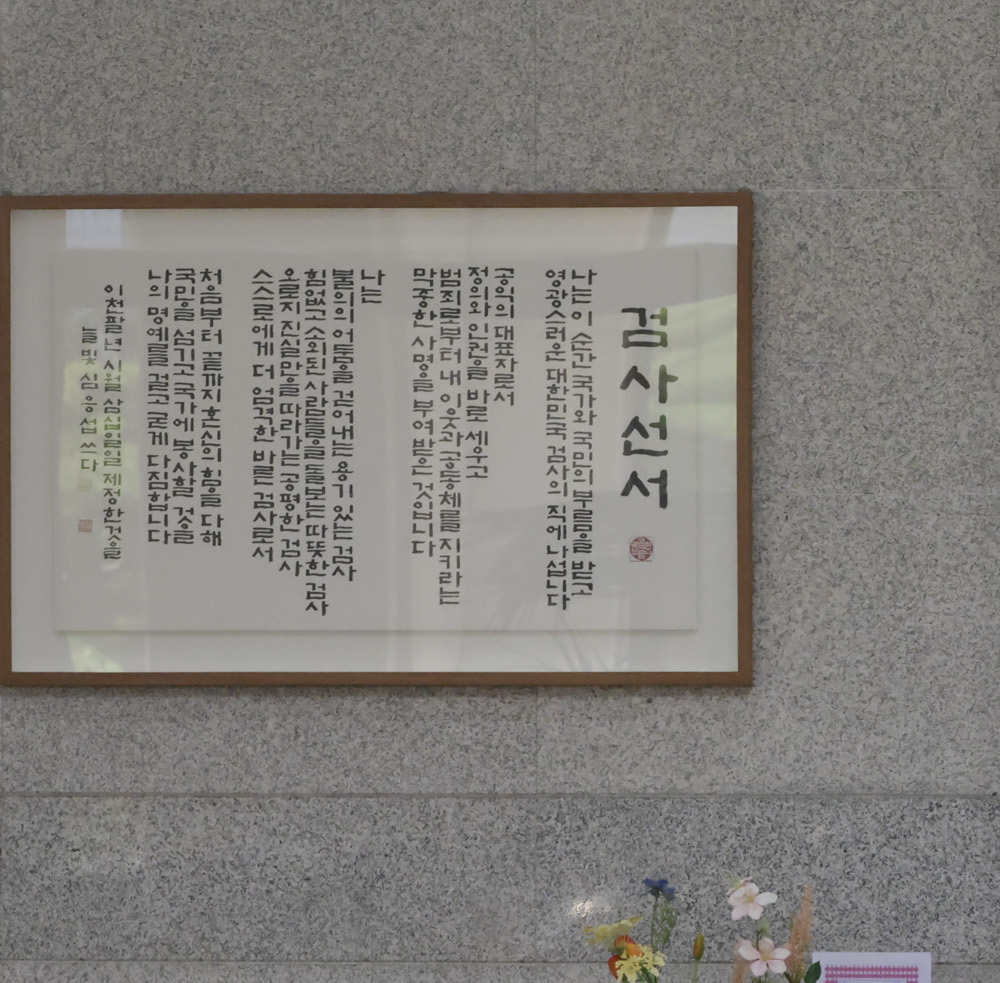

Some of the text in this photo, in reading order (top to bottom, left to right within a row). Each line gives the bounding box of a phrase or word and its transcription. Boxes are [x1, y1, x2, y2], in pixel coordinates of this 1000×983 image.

[148, 269, 172, 299] 나의
[200, 268, 222, 344] 처음부터
[332, 268, 354, 324] 불의의
[361, 269, 386, 304] 나는
[412, 268, 437, 328] 막중한
[147, 307, 169, 367] 명예를
[332, 328, 354, 384] 어둠을
[411, 336, 437, 392] 사명을
[493, 268, 518, 406] 공익의 대표자로서
[103, 360, 122, 393] 시월
[148, 373, 169, 405] 걸고
[465, 266, 490, 478] 정의와 인권을 바로 세우고
[172, 268, 197, 544] 국민을 섬기고 국가에 봉사할 것을
[201, 406, 221, 462] 혼신의
[252, 269, 278, 562] 스스로에게 더 엄격한 바른 검사로서
[277, 268, 304, 577] 오로지 진실만을 따라가는 공평한 검사
[571, 269, 597, 596] 나는 이 순간 국가와 국민의 부름을 받고
[620, 307, 678, 509] 검사선서
[80, 442, 99, 472] 쓰다
[304, 268, 330, 616] 힘없고 소외된 사람들을 돌보는 따뜻한 검사
[438, 269, 464, 605] 범죄로부터 내 이웃과 공동체를 지키라는
[545, 269, 570, 610] 영광스러운 대한민국 검사의 직에 나섭니다
[147, 455, 173, 544] 다짐합니다
[200, 467, 221, 507] 힘을
[200, 514, 224, 546] 다해
[332, 505, 353, 540] 있는
[411, 482, 436, 557] 것입니다
[332, 546, 357, 581] 검사
